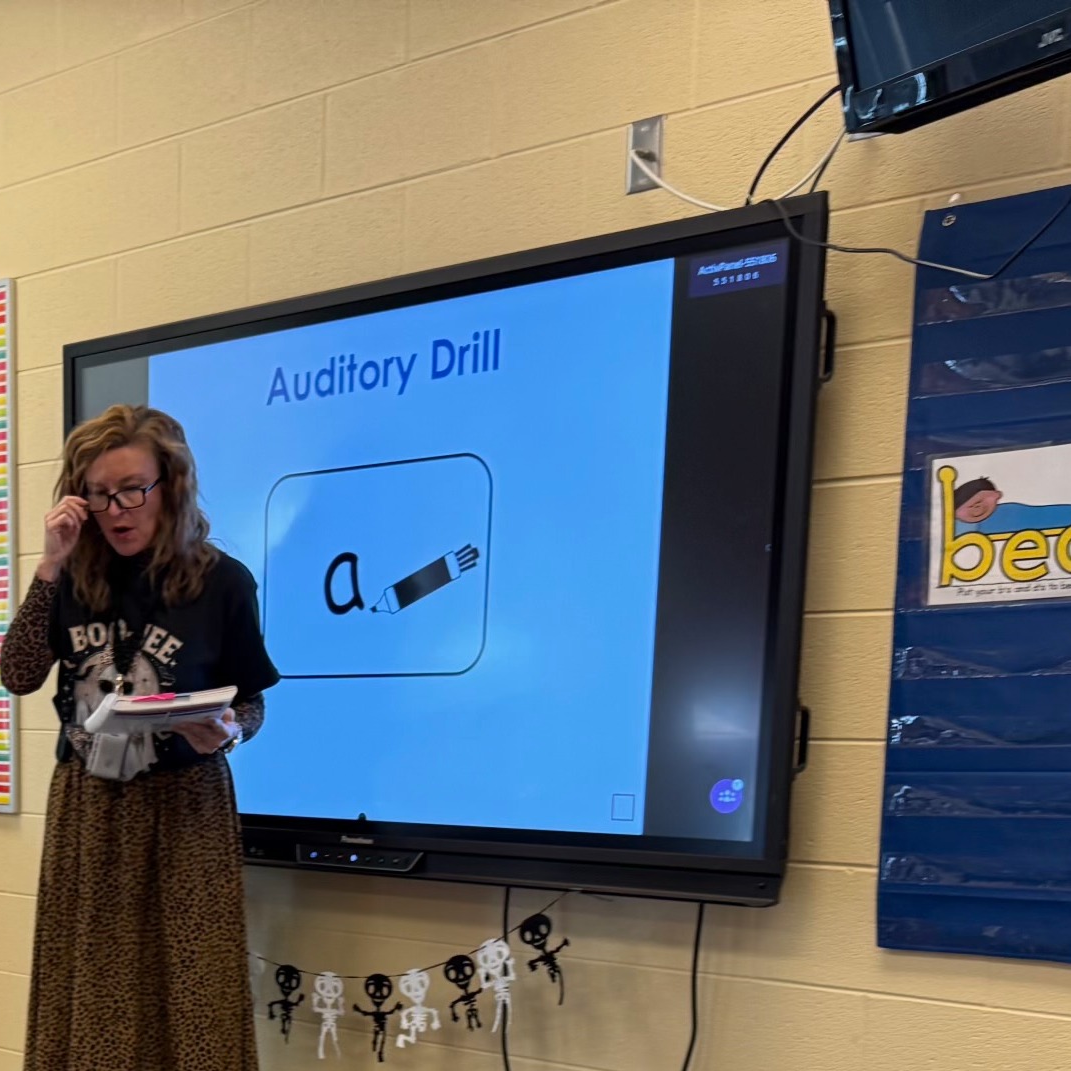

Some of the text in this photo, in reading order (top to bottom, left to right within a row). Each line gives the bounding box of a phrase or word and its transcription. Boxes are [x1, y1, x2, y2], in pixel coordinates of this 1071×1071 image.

[267, 328, 501, 406] Auditory Drill
[938, 465, 1071, 588] be
[324, 552, 365, 615] a
[957, 588, 974, 596] Put
[976, 588, 995, 597] your
